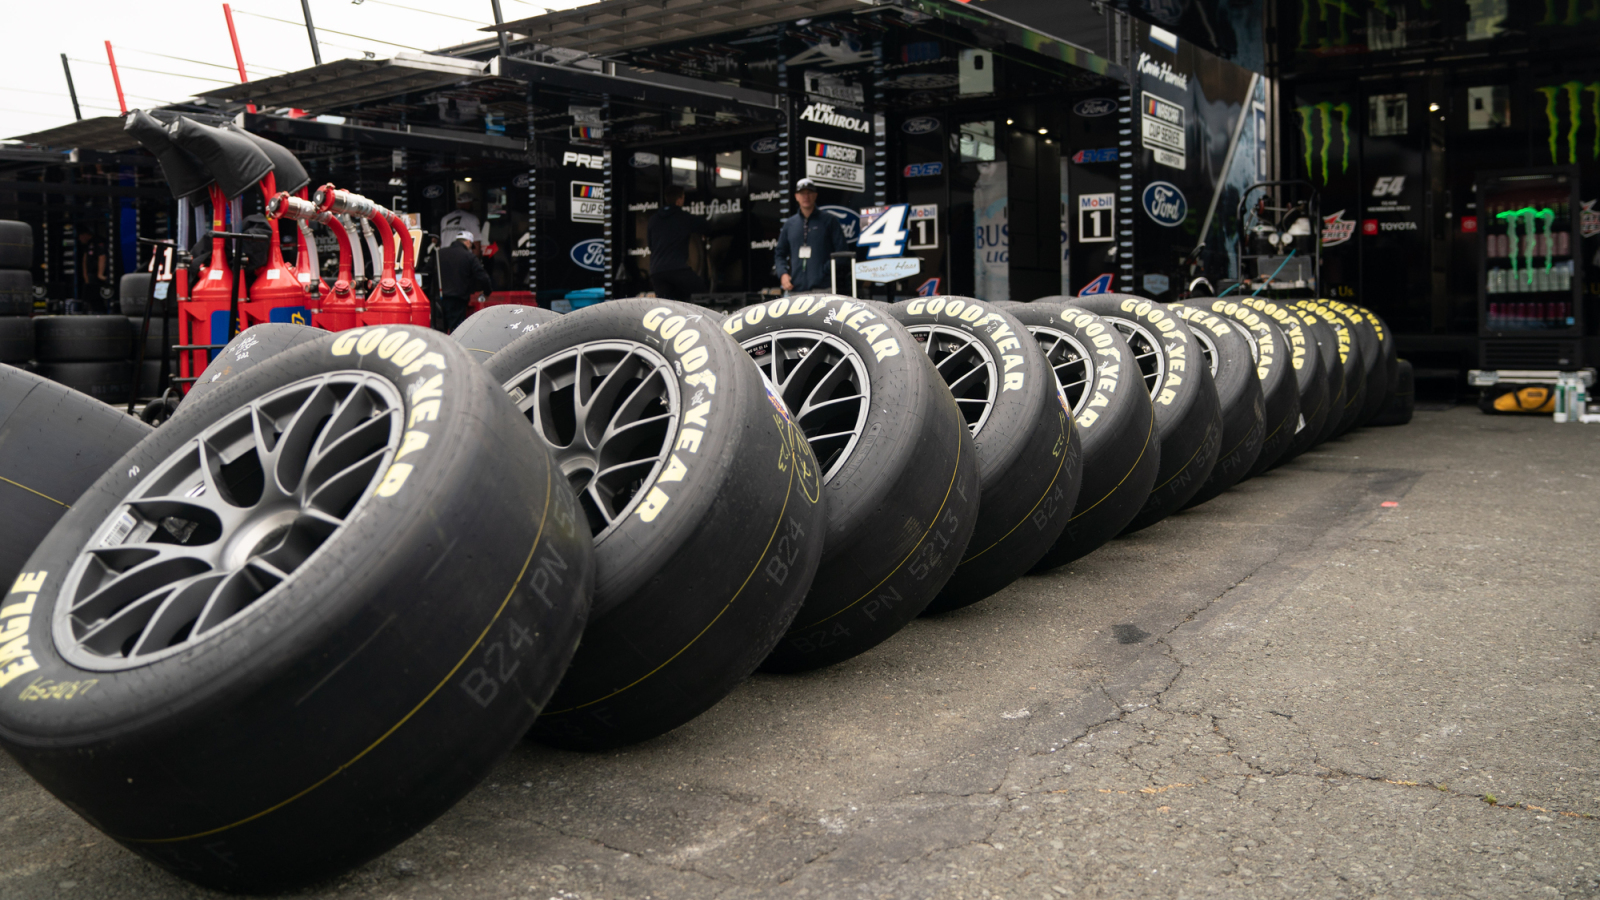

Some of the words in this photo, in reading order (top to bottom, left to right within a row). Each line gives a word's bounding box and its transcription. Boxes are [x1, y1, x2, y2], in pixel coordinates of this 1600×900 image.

[1136, 52, 1160, 78] Kevin
[799, 104, 870, 134] ALMIROLA
[814, 102, 836, 113] ARIC
[1157, 101, 1180, 124] NASCAR
[1148, 123, 1160, 138] CUP
[1161, 127, 1180, 146] SERIES
[825, 144, 858, 163] NASCAR
[815, 163, 831, 176] CUP
[832, 165, 858, 181] SERIES
[903, 161, 943, 178] 4EVER
[1371, 174, 1407, 198] 54
[580, 203, 596, 214] CUP
[596, 204, 604, 214] S
[909, 207, 935, 217] Mobil
[1081, 196, 1113, 208] Mobil
[1151, 185, 1180, 220] Ford
[857, 203, 909, 259] 4
[916, 220, 926, 245] 1
[1089, 211, 1101, 237] 1
[1379, 221, 1418, 232] TOYOTA
[1077, 273, 1115, 297] 4
[1169, 470, 1192, 495] PN
[1032, 484, 1064, 531] B24
[765, 515, 805, 587] B24
[862, 585, 904, 622] PN
[908, 507, 960, 582] 5213
[0, 570, 48, 689] EAGLE
[459, 617, 534, 709] B24
[529, 541, 569, 609] PN
